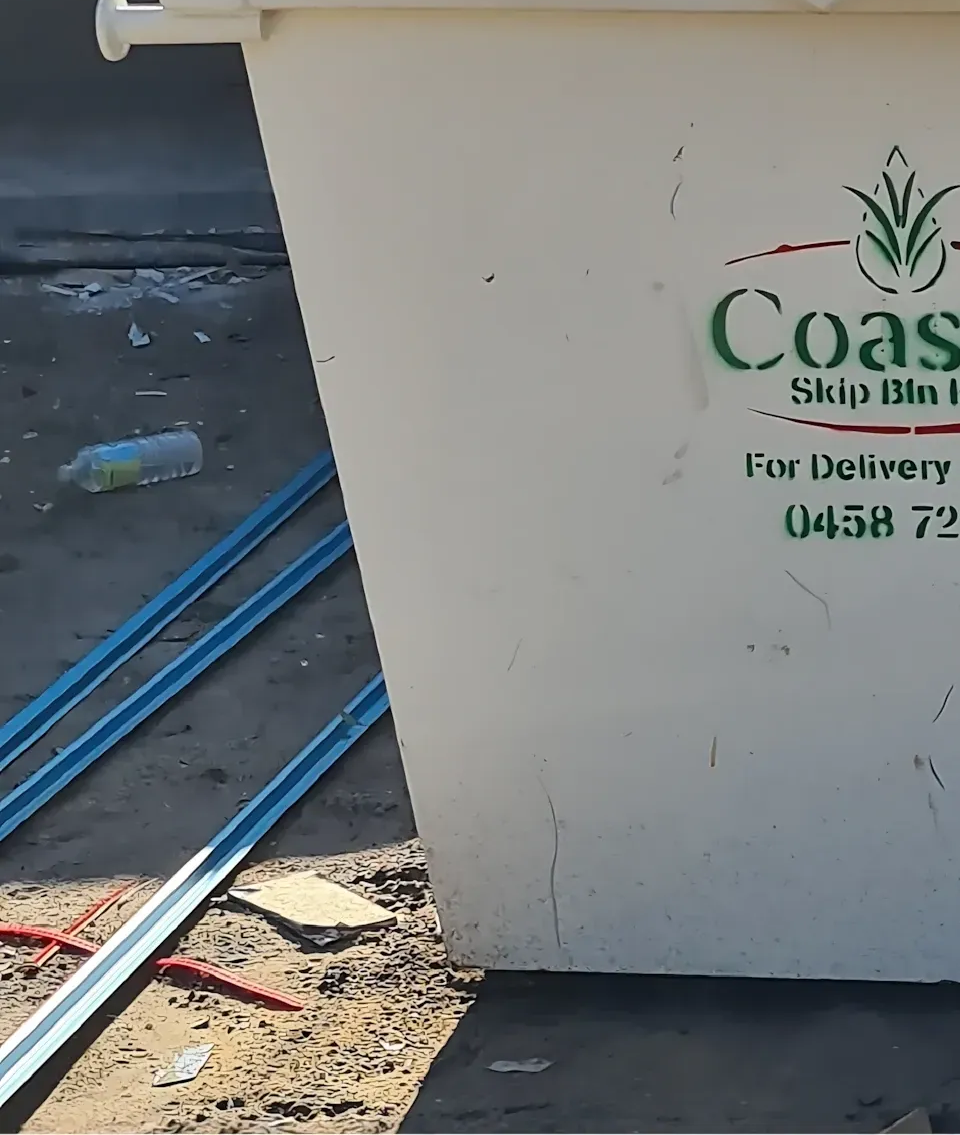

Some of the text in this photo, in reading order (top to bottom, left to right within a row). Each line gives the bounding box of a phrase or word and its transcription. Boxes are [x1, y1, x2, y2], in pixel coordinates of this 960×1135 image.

[791, 377, 871, 409] Skip
[882, 378, 938, 405] Bin
[745, 452, 800, 480] For
[812, 454, 951, 485] Delivery
[785, 504, 895, 539] 0458
